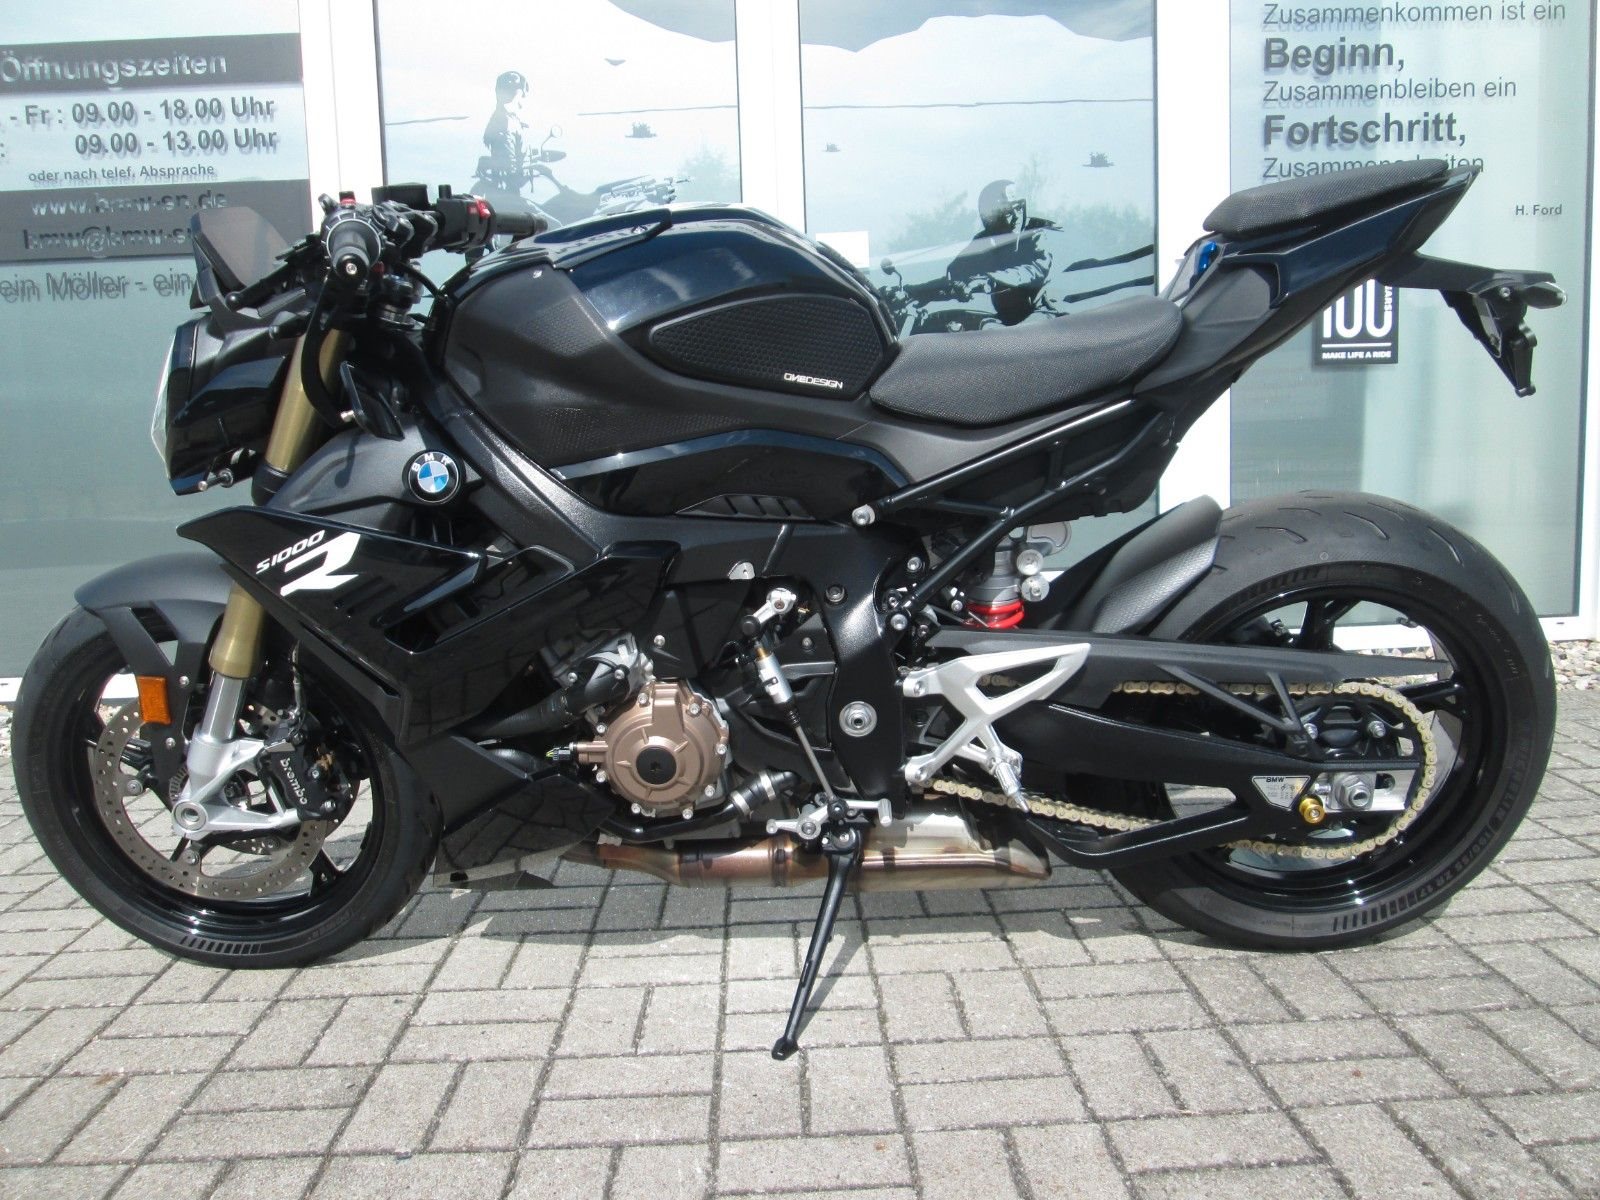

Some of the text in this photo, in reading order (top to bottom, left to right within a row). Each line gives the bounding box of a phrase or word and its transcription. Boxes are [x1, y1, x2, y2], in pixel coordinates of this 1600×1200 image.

[1263, 1, 1566, 25] Zusammenkommen ist ein
[0, 51, 228, 85] Öffnungszeiten
[1264, 37, 1405, 76] Beginn,
[1263, 77, 1516, 102] Zusammenbleiben ein
[71, 101, 135, 123] 09.00
[159, 98, 222, 120] 18.00
[230, 96, 275, 117] Uhr
[75, 132, 138, 155] 09.00
[162, 130, 225, 151] 13.00
[233, 127, 277, 149] Uhr
[1264, 112, 1466, 146] Fortschritt,
[28, 163, 215, 182] oder nach telef. Absprache
[1515, 204, 1562, 216] H. Ford
[46, 271, 129, 300] Möller
[1347, 351, 1364, 359] LIFE
[1372, 350, 1392, 358] RIDE
[411, 452, 454, 473] BMW
[255, 529, 326, 575] S1000
[280, 757, 308, 805] brembo
